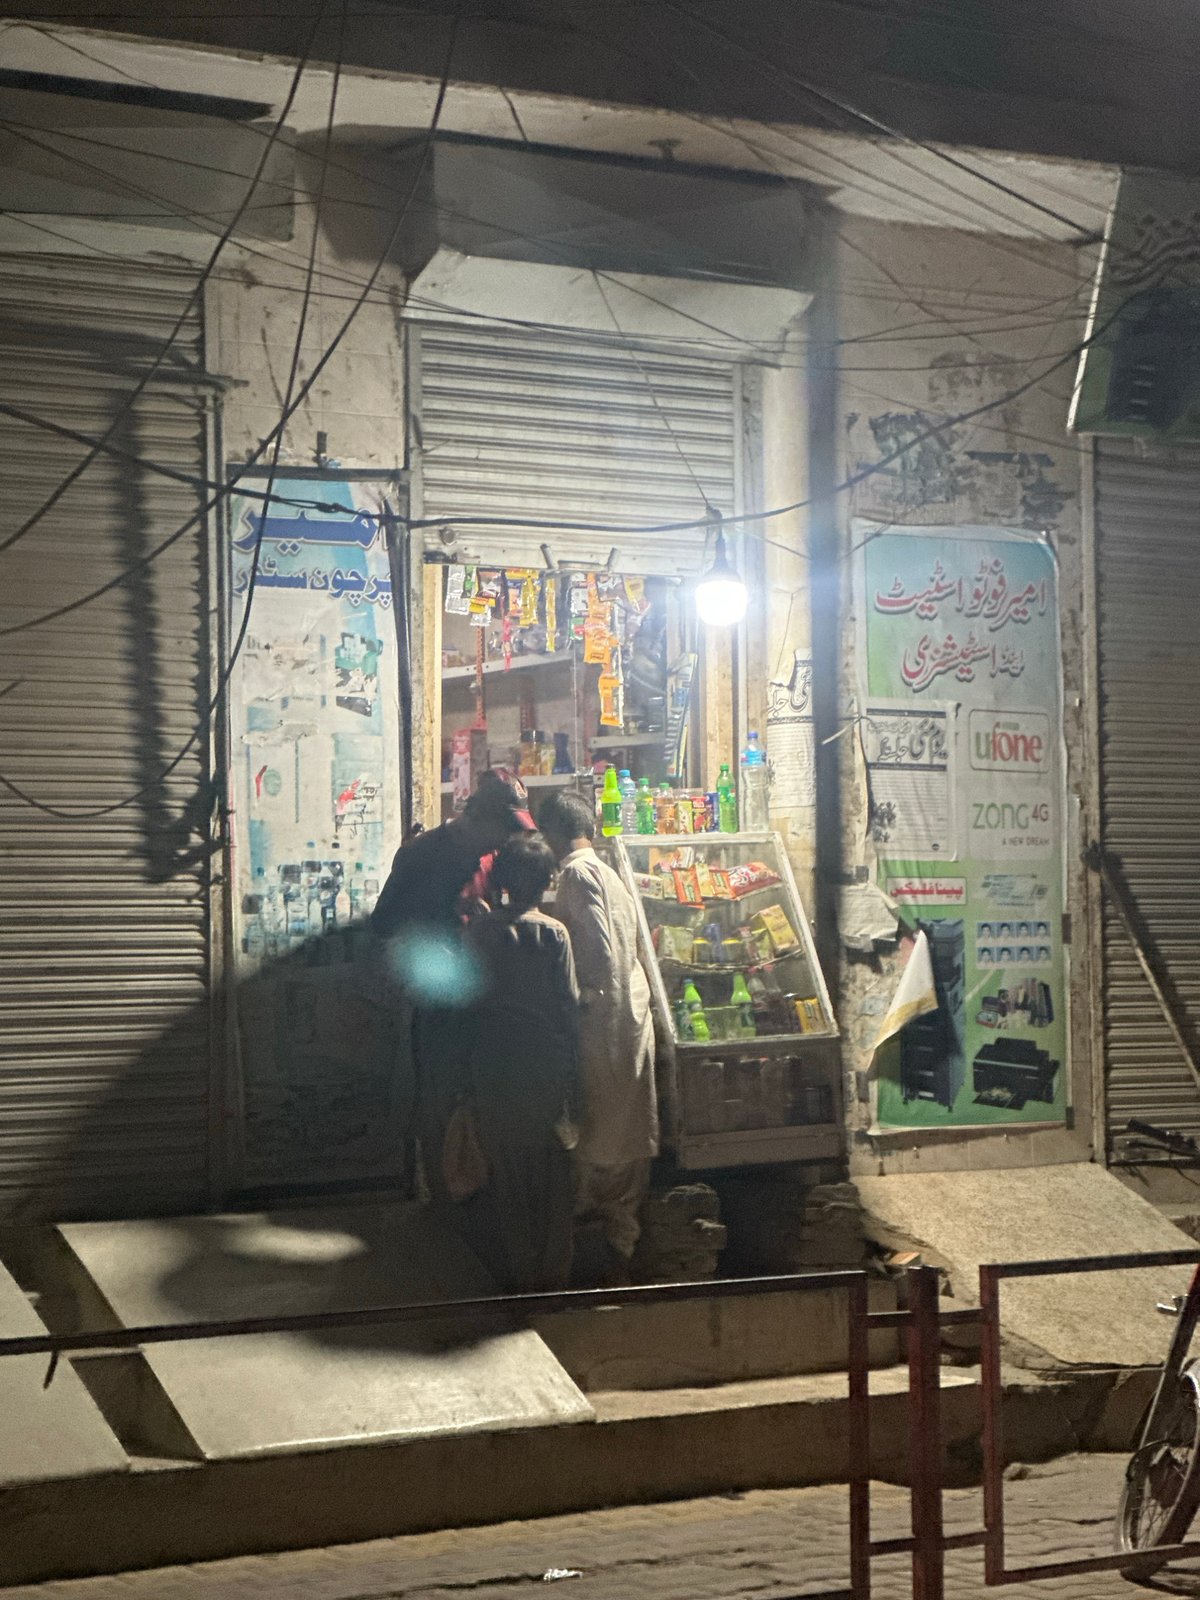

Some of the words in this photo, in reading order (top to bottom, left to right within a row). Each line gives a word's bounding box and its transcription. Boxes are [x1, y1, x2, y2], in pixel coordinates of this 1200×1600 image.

[232, 508, 389, 556] میر
[308, 568, 392, 608] پرچون
[965, 558, 1006, 617] فوٹو
[989, 577, 1047, 631] امیر
[975, 722, 1043, 763] ufone
[1031, 802, 1049, 823] 4G
